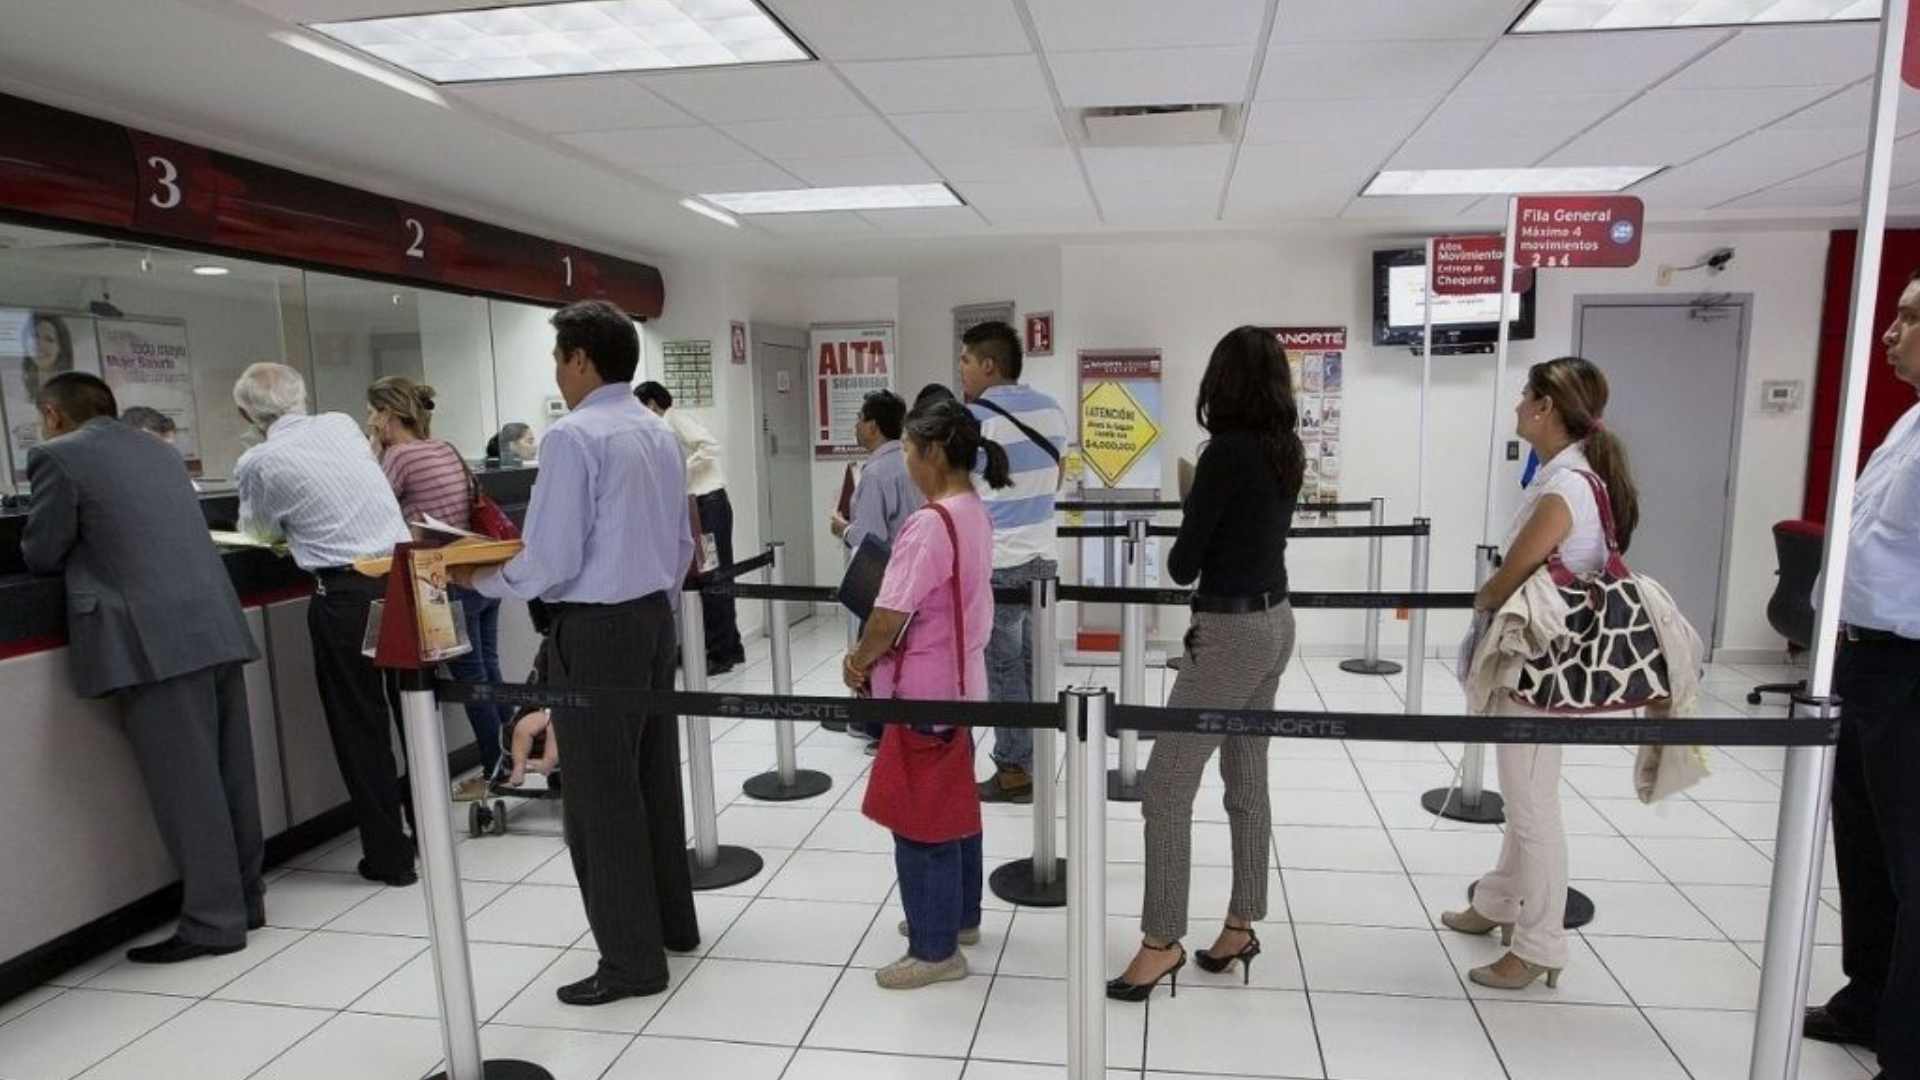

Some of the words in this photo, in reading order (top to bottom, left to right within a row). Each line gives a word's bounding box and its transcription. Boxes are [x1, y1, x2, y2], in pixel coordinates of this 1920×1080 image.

[147, 156, 181, 209] 3
[1523, 208, 1550, 222] Fila
[1554, 208, 1611, 222] General
[405, 218, 426, 259] 2
[1572, 226, 1582, 237] 4
[1520, 240, 1599, 251] movimientos
[1438, 249, 1504, 261] Movimiento
[1531, 253, 1541, 267] 2
[1547, 256, 1557, 267] a
[1560, 253, 1571, 267] 4
[561, 256, 573, 288] 1
[1437, 275, 1496, 287] Chequeras
[1275, 331, 1344, 344] ANORTE
[818, 340, 888, 375] ALTA
[743, 701, 848, 719] BANORTE
[1225, 716, 1345, 735] BANORTE
